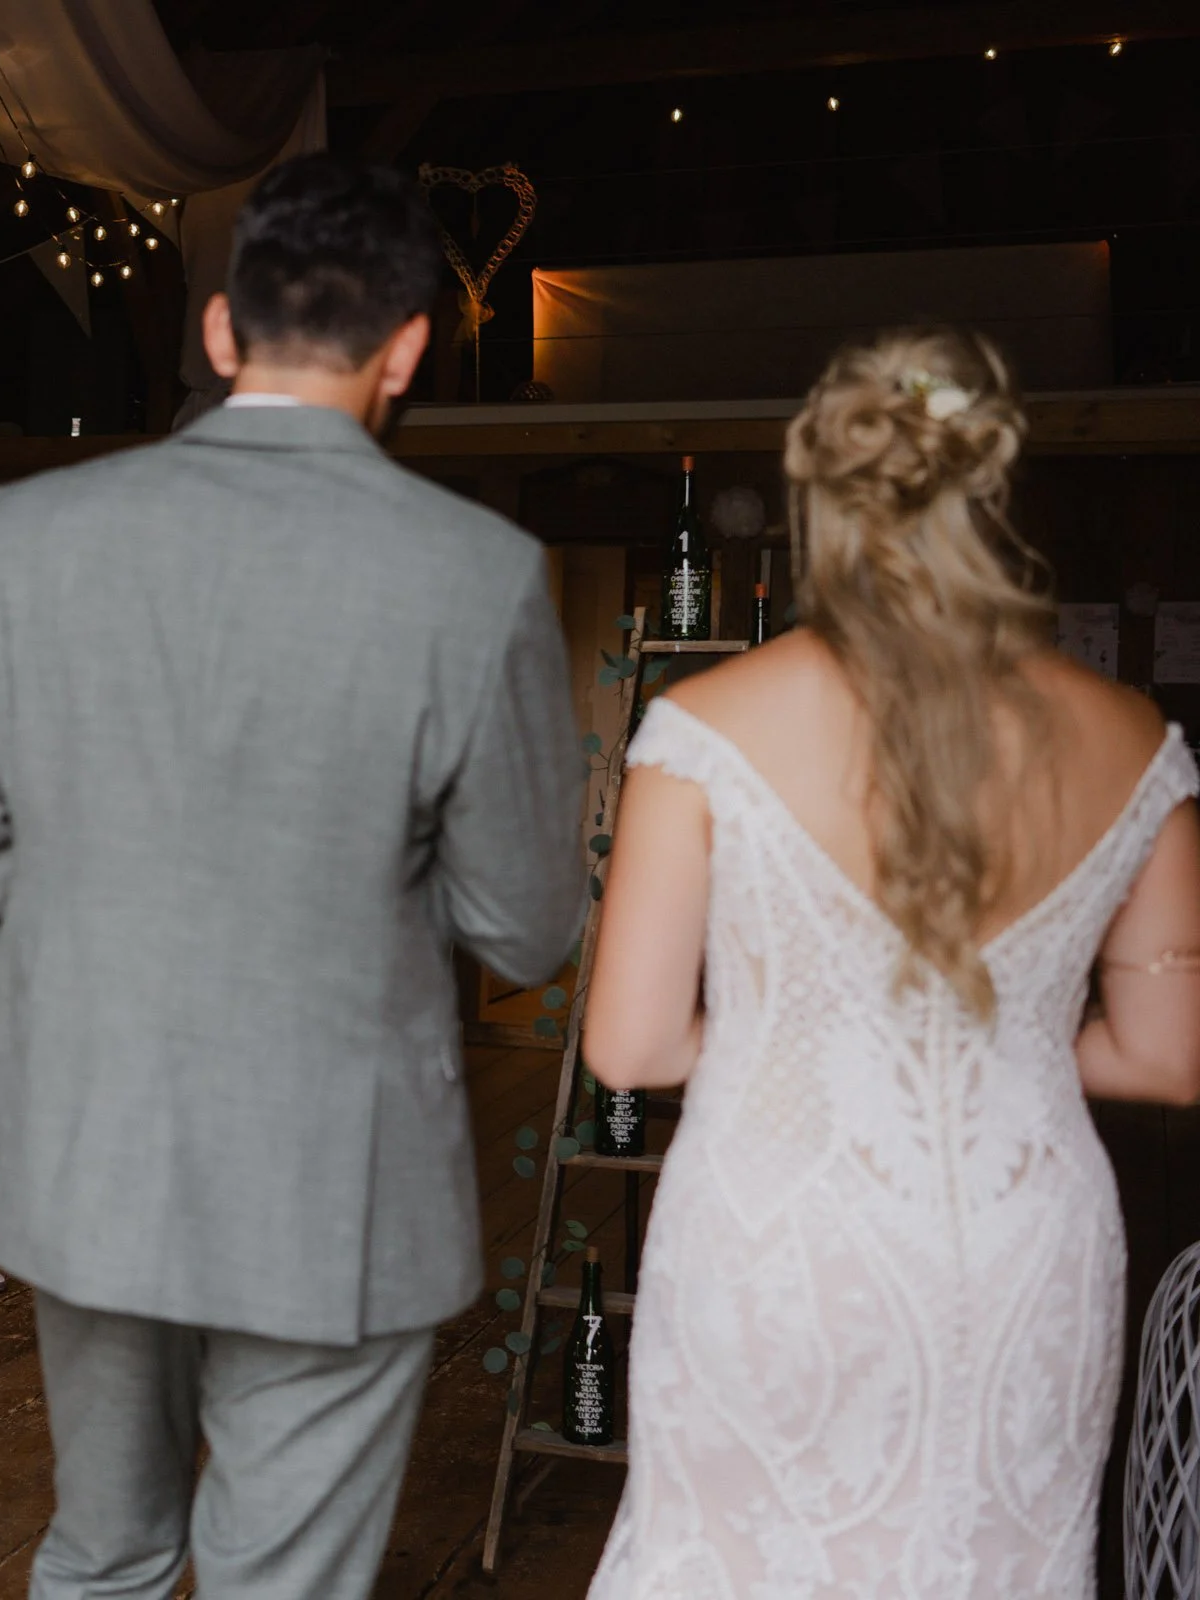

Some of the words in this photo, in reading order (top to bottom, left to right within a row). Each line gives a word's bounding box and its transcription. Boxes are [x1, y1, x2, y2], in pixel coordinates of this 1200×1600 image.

[679, 531, 688, 552] 1
[582, 1315, 603, 1347] 7
[575, 1364, 605, 1372] VICTORIA
[580, 1385, 598, 1393] SILKE
[575, 1392, 603, 1400] MICHAEL
[583, 1419, 598, 1427] SUSI
[575, 1425, 602, 1433] FLORIAN
